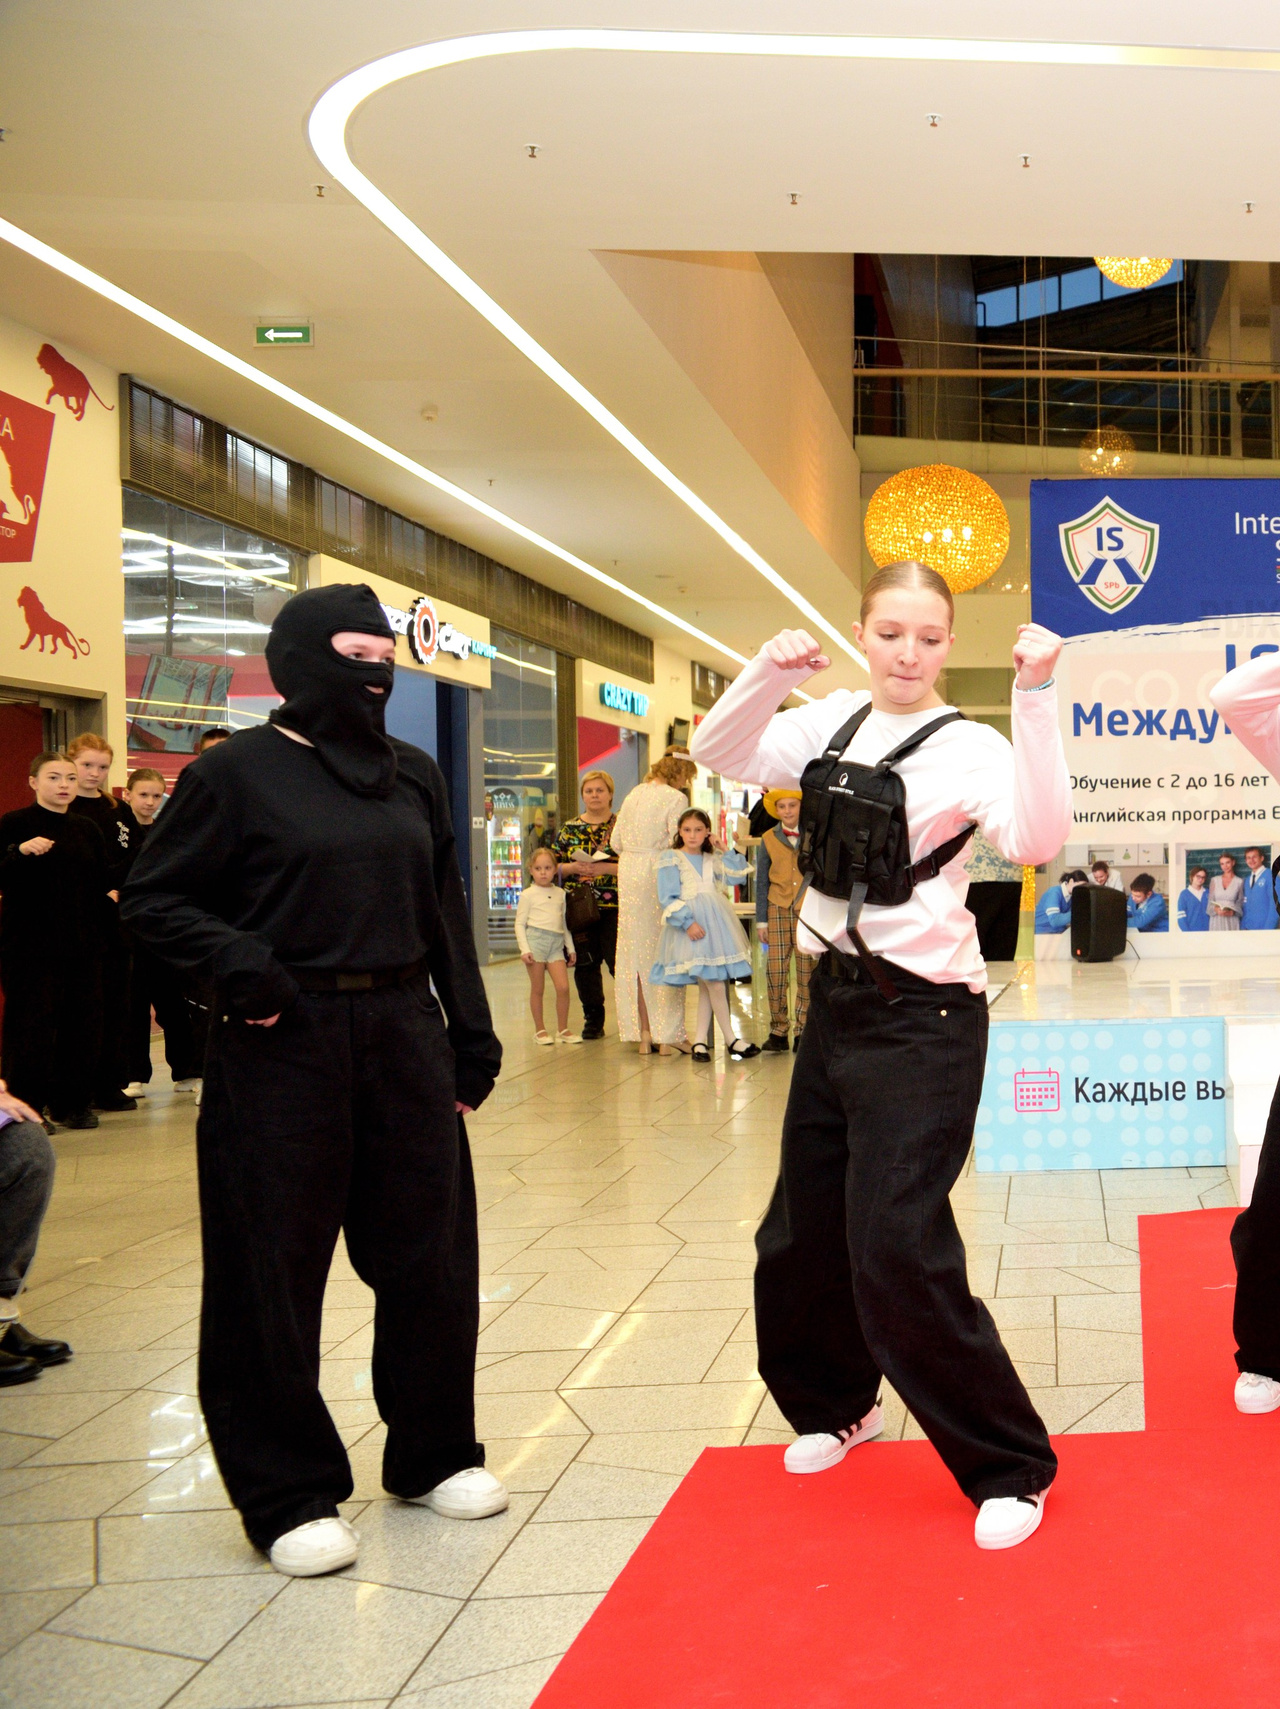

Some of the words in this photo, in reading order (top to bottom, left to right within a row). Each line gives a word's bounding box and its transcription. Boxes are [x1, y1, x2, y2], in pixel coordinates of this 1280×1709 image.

[1096, 527, 1124, 551] IS
[603, 681, 634, 713] CRAZY
[1157, 779, 1165, 788] с
[1171, 774, 1181, 788] 2
[1186, 776, 1208, 790] до
[1214, 774, 1236, 788] 16
[1240, 775, 1270, 787] лет
[1172, 809, 1267, 824] программа
[1074, 1076, 1187, 1107] Каждые
